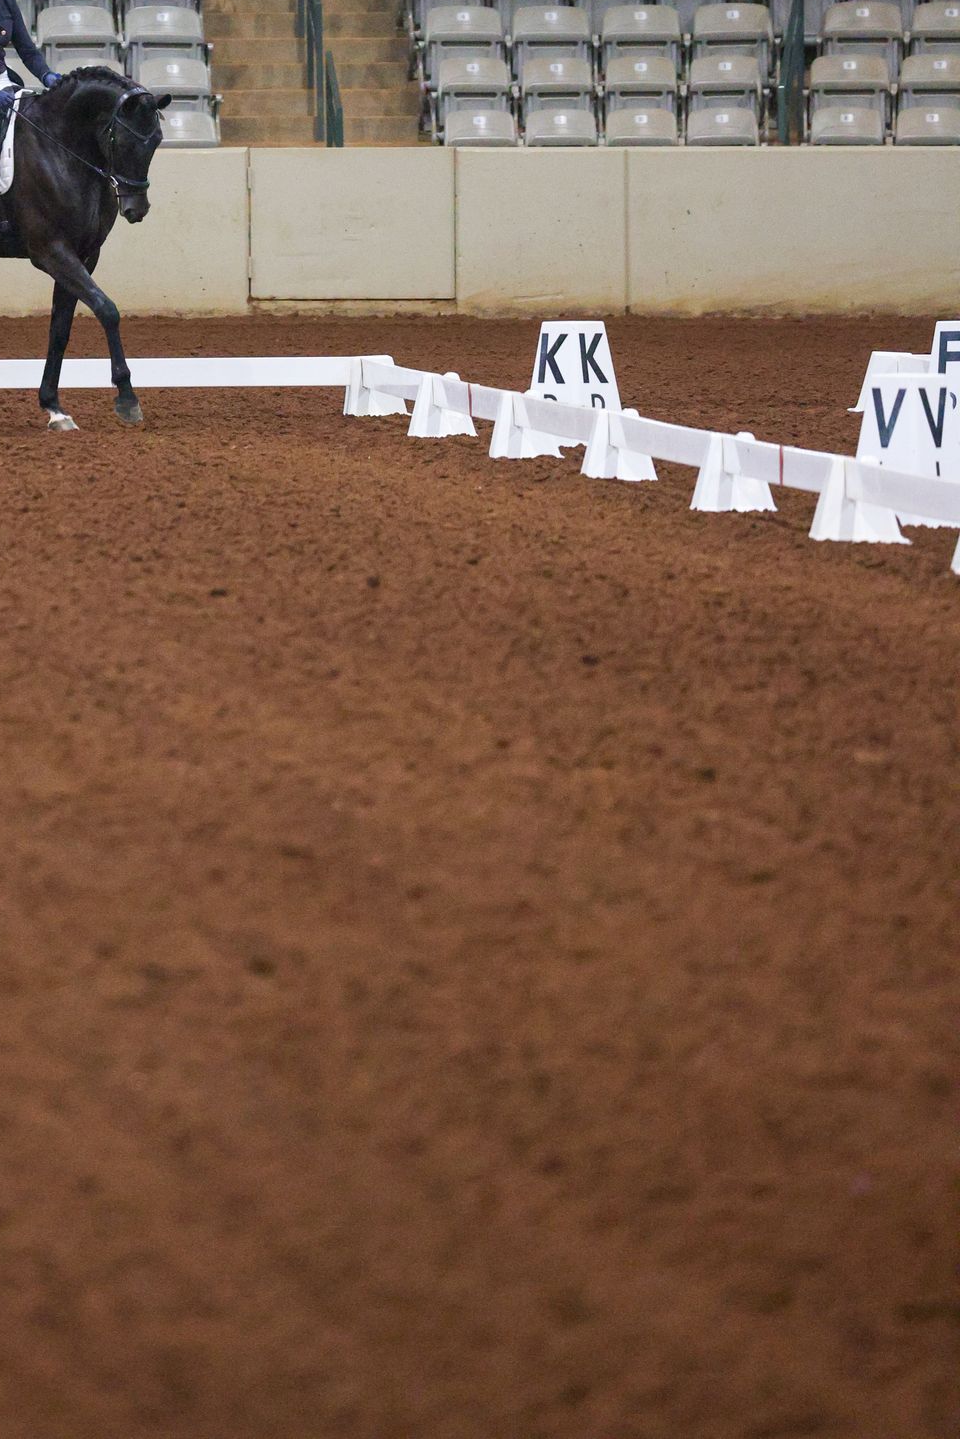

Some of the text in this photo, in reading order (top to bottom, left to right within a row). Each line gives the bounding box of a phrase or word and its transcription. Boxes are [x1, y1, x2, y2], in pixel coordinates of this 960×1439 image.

[538, 333, 609, 385] K K
[872, 387, 947, 448] V V
